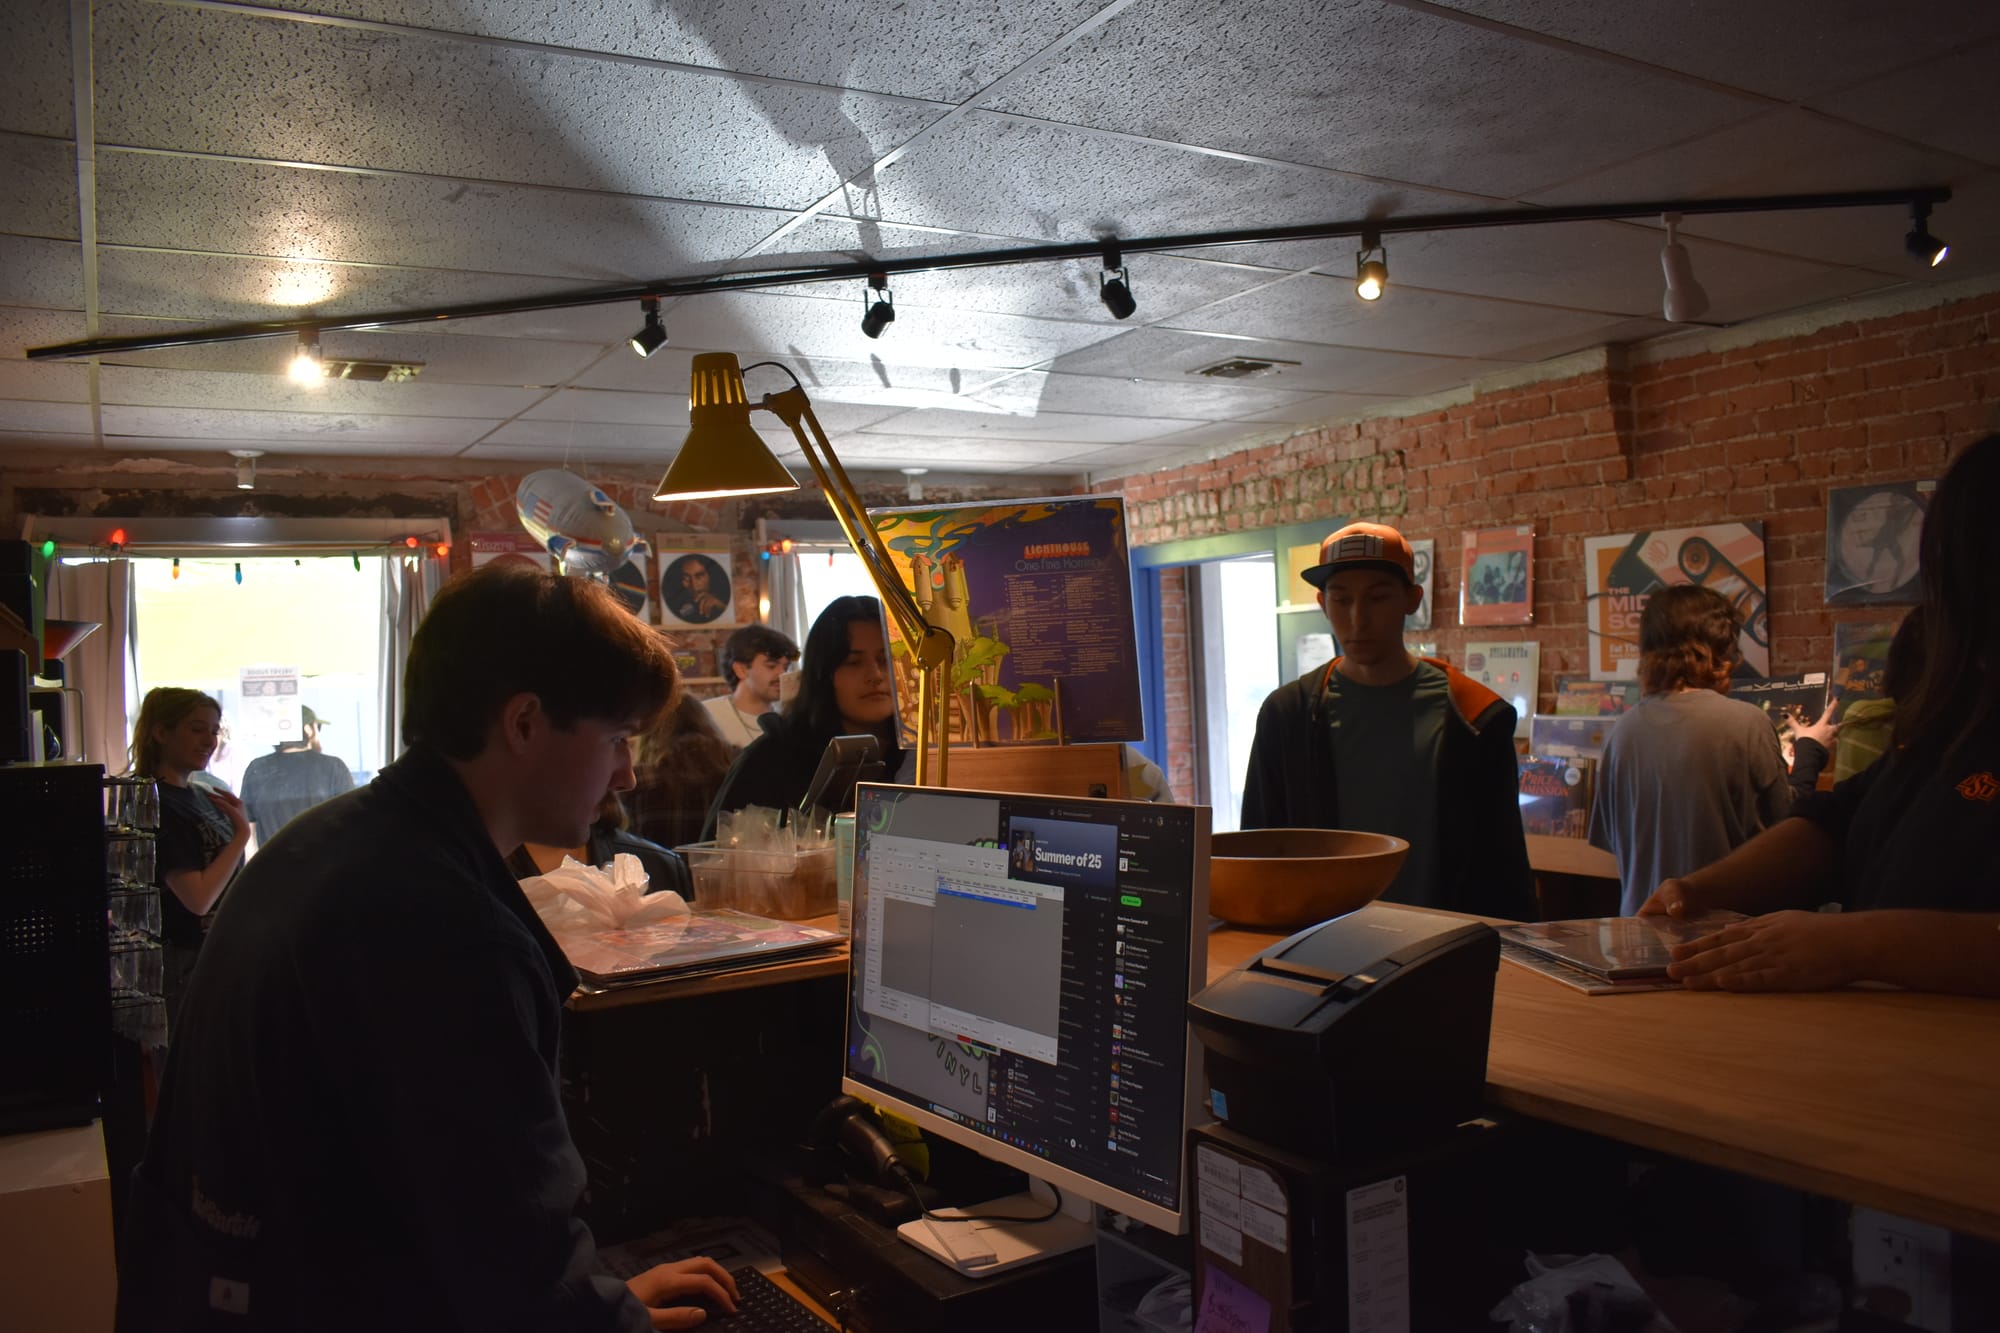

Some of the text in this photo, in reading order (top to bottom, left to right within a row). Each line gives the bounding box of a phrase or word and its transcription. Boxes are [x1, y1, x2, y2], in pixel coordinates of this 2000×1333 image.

[1015, 559, 1040, 572] One
[1034, 847, 1075, 865] Summer
[1076, 852, 1088, 868] of
[1087, 853, 1102, 870] 25
[927, 1032, 983, 1096] INYL
